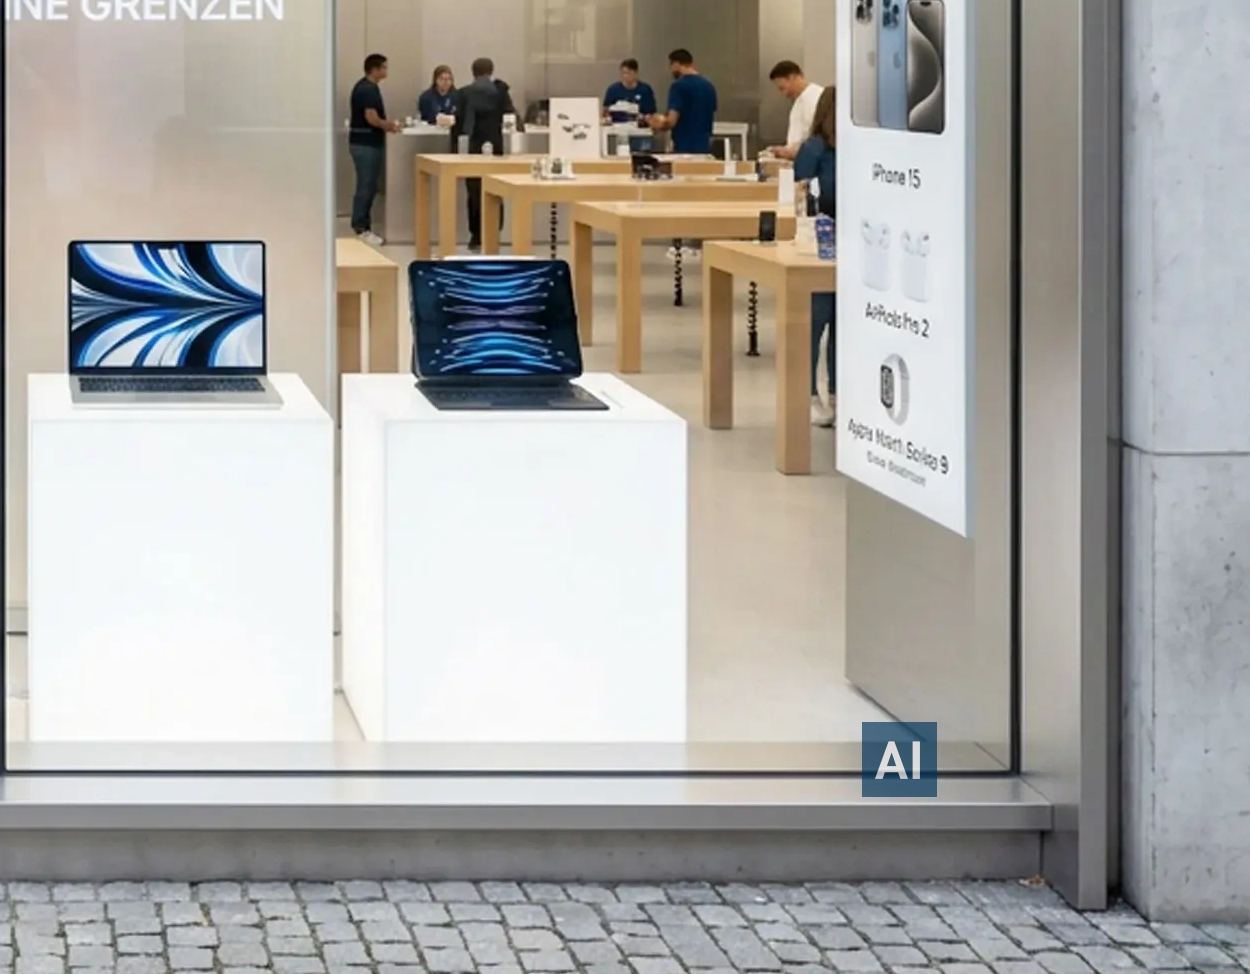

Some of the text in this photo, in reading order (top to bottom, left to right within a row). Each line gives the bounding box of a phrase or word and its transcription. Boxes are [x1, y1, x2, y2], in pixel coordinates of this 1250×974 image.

[908, 169, 921, 189] 15
[921, 319, 930, 339] 2
[940, 454, 950, 475] 9
